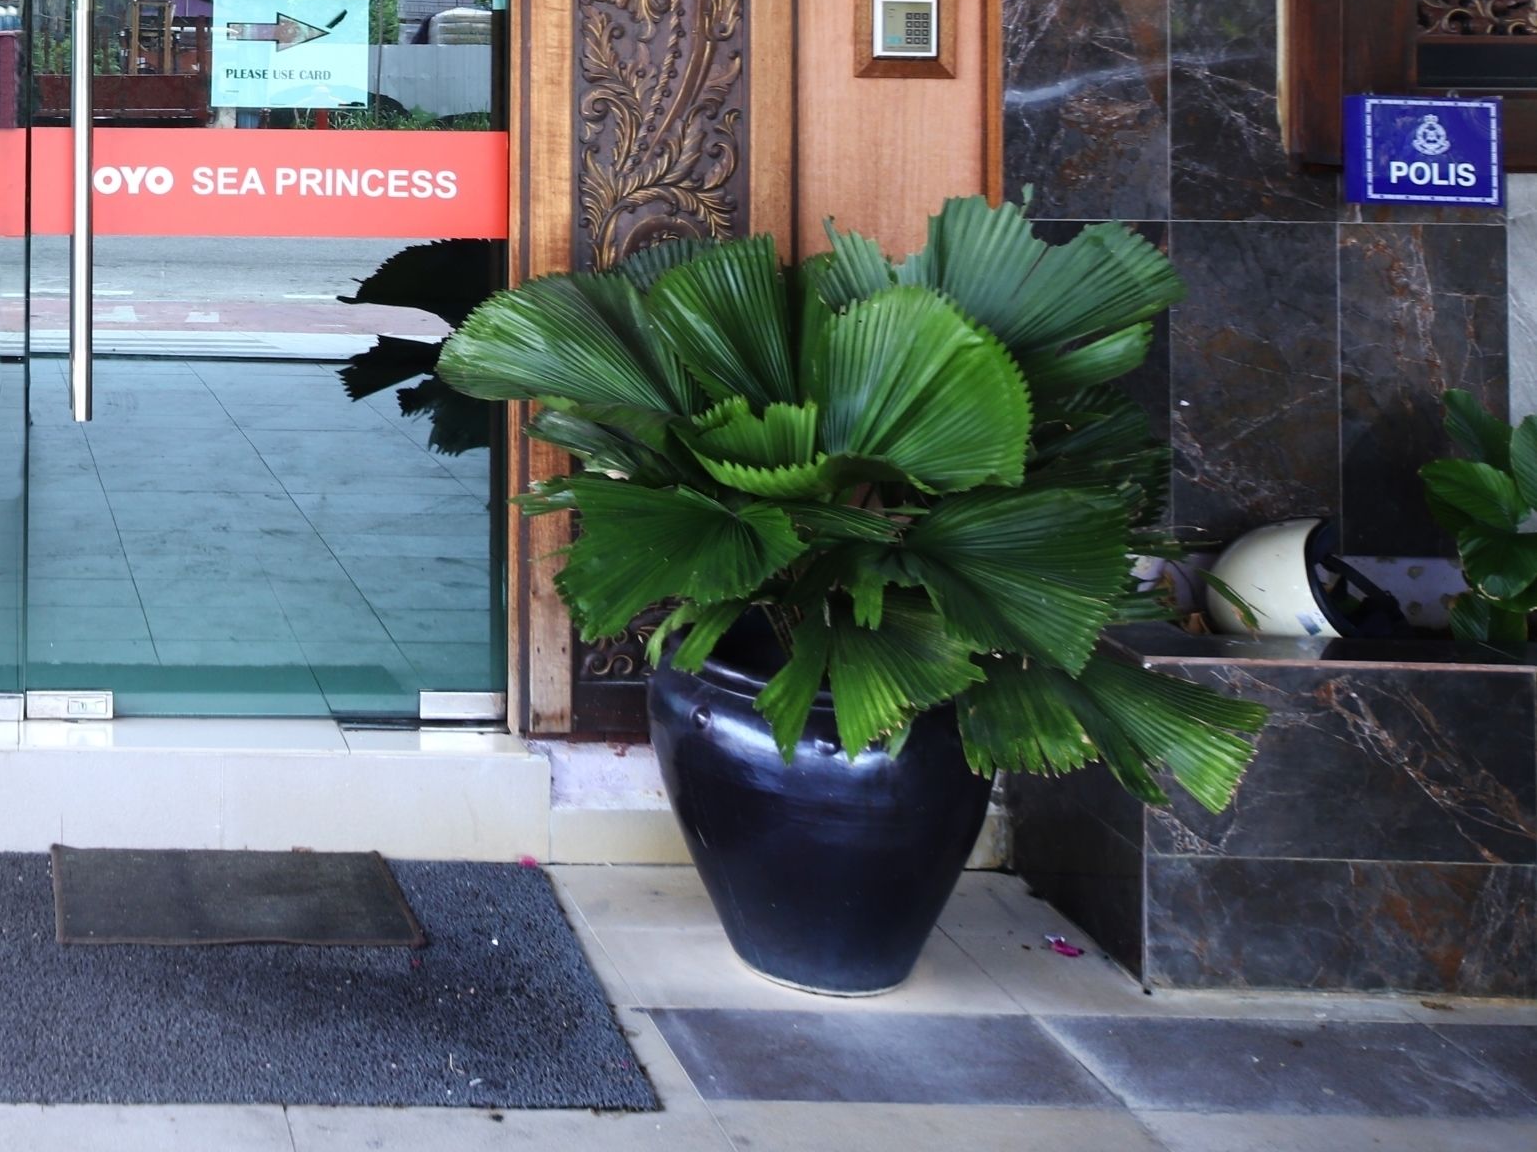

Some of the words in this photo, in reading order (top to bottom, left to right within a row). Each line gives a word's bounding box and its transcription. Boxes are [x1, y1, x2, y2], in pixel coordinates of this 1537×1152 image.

[226, 68, 269, 80] PLEASE
[273, 69, 295, 80] USE
[299, 69, 332, 81] CARD
[94, 166, 174, 195] OYO
[192, 167, 265, 195] SEA
[275, 168, 458, 199] PRINCESS
[1389, 161, 1477, 187] POLIS
